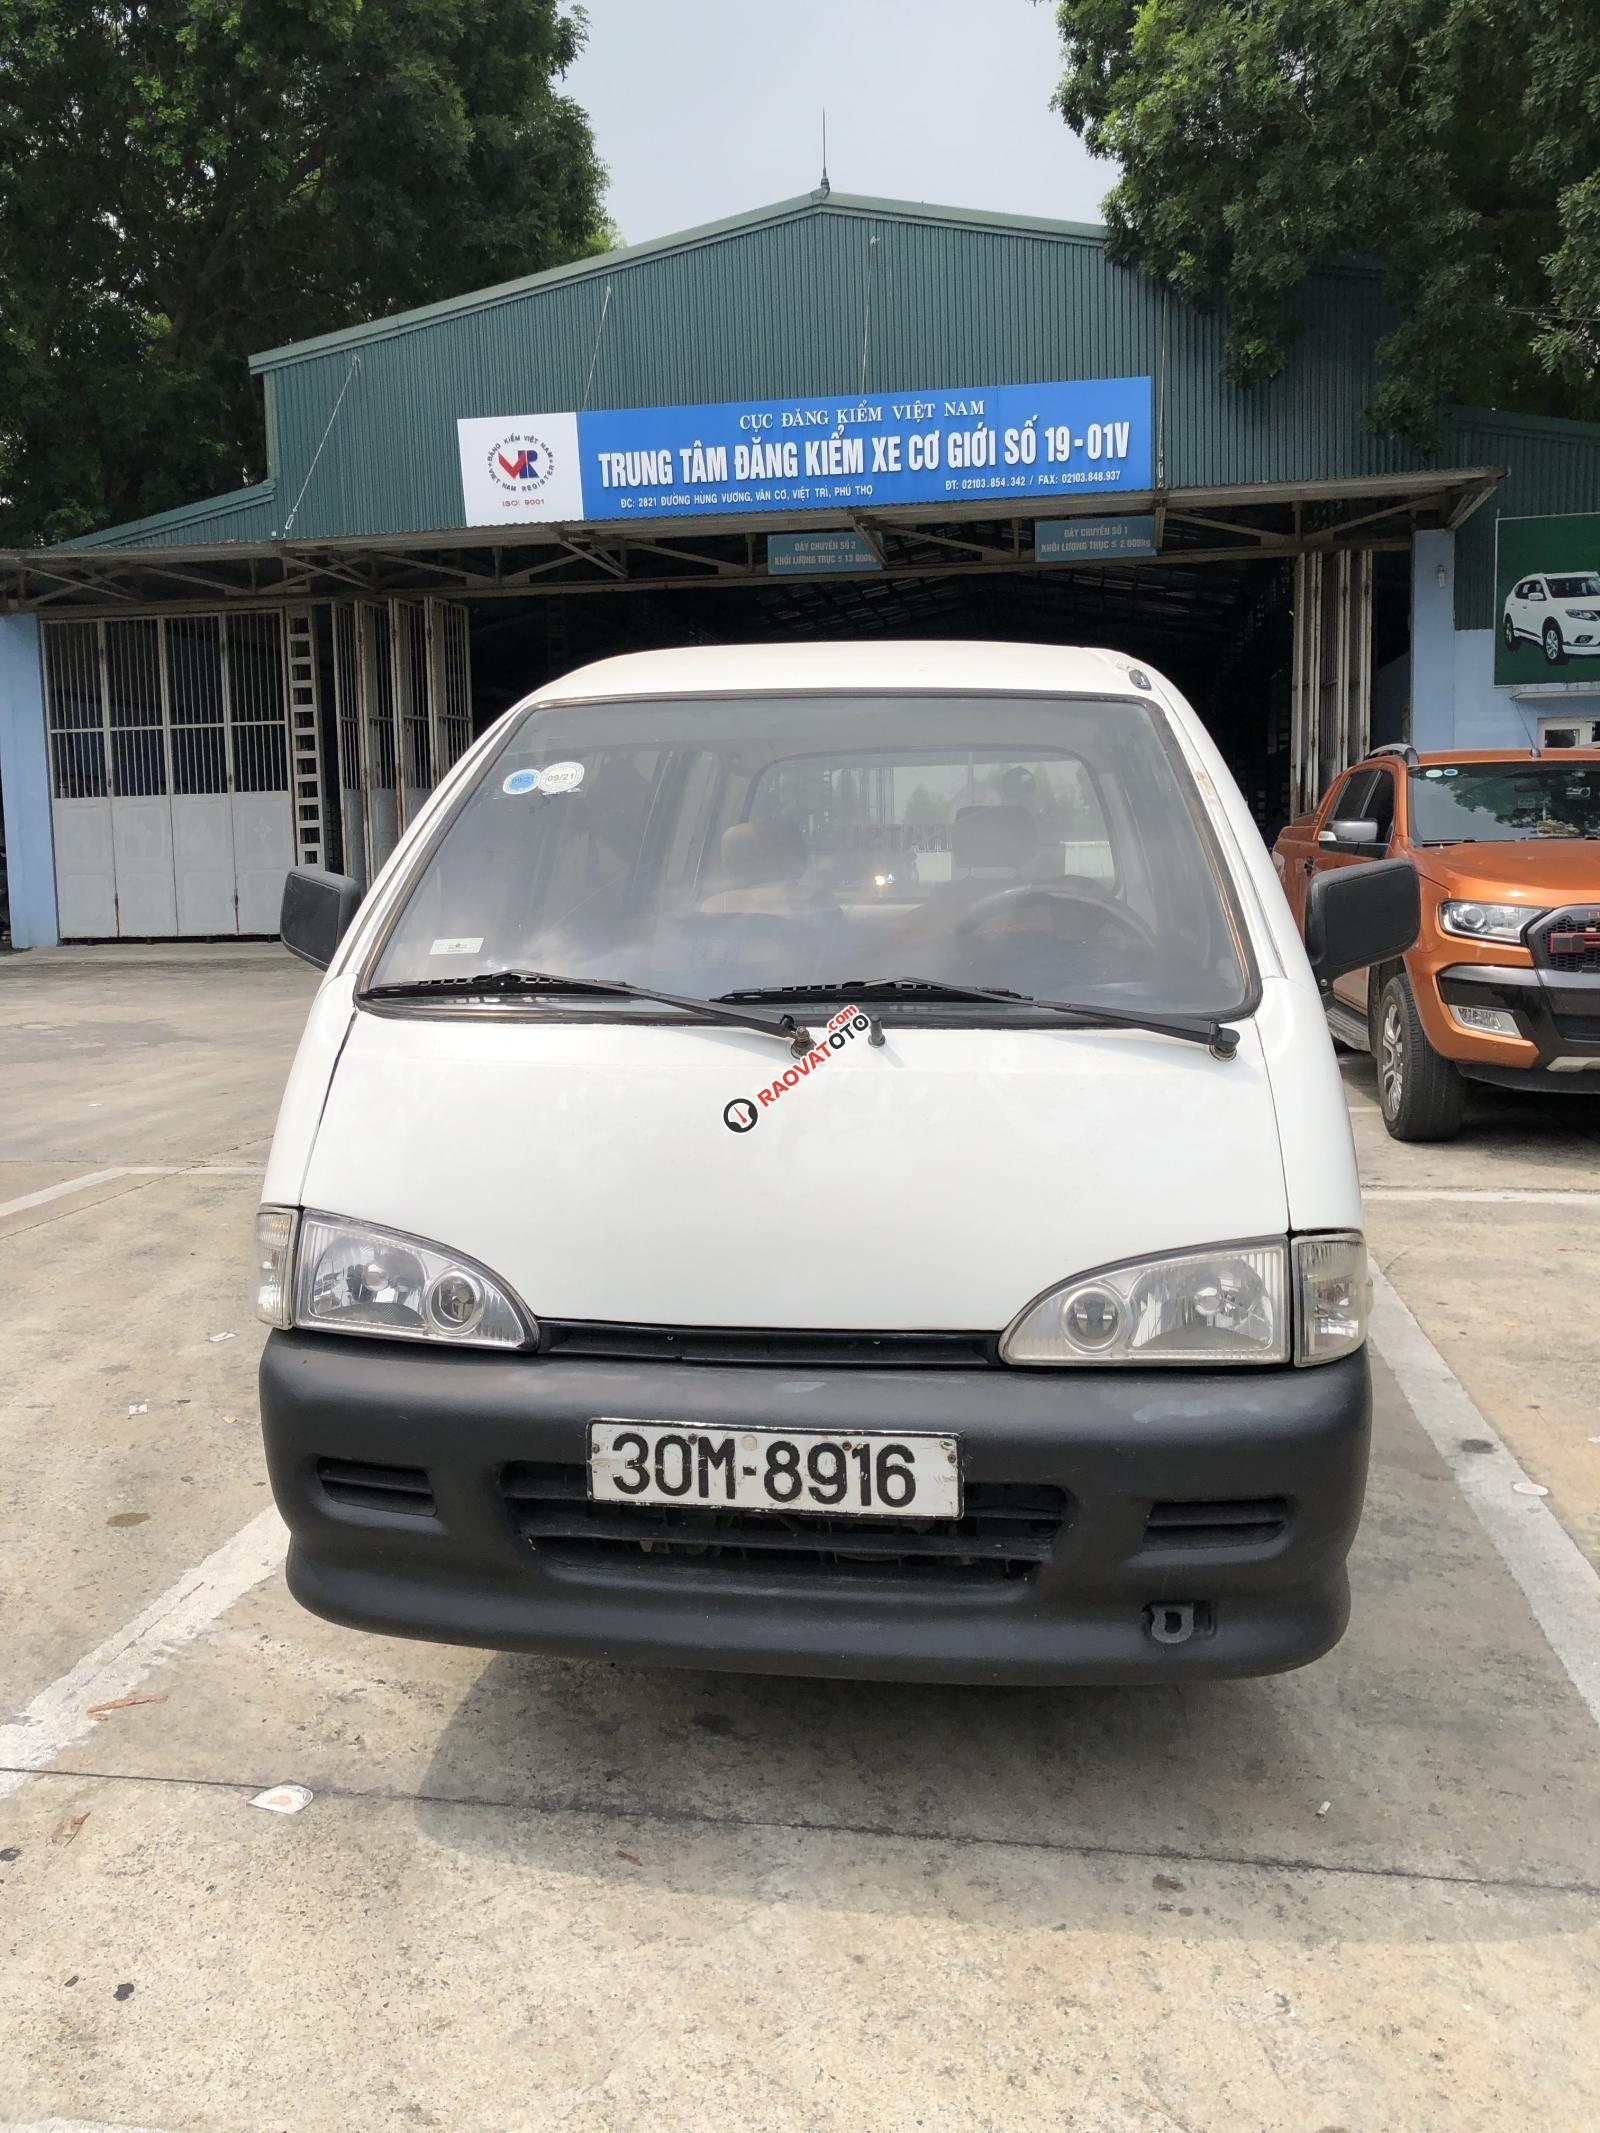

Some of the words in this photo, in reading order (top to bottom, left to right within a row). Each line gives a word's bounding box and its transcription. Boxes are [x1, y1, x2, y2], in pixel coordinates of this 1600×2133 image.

[739, 412, 773, 433] CỤC
[780, 408, 829, 427] ĐĂNG
[836, 400, 882, 424] KIỂM
[891, 400, 935, 423] VIỆT
[943, 400, 985, 417] NAM
[539, 442, 554, 459] NAM
[598, 450, 673, 488] TRUNG
[679, 440, 728, 484] TÂM
[734, 437, 798, 481] ĐĂNG
[805, 425, 864, 476] KIỂM
[872, 435, 902, 473] XE
[908, 430, 940, 471] CƠ
[947, 421, 996, 469] GIỚI
[1004, 414, 1039, 465] SỐ
[945, 479, 959, 490] ĐT:
[1038, 475, 1059, 485] FAX:
[1061, 470, 1121, 483] 02103.848.937
[620, 498, 635, 508] ĐC:
[638, 497, 657, 507] 2821
[661, 492, 691, 506] ĐƯỜNG
[792, 486, 810, 501] VIỆT
[855, 484, 873, 498] THỌ
[547, 772, 575, 782] 09/21
[612, 1432, 916, 1508] 30M-8916
